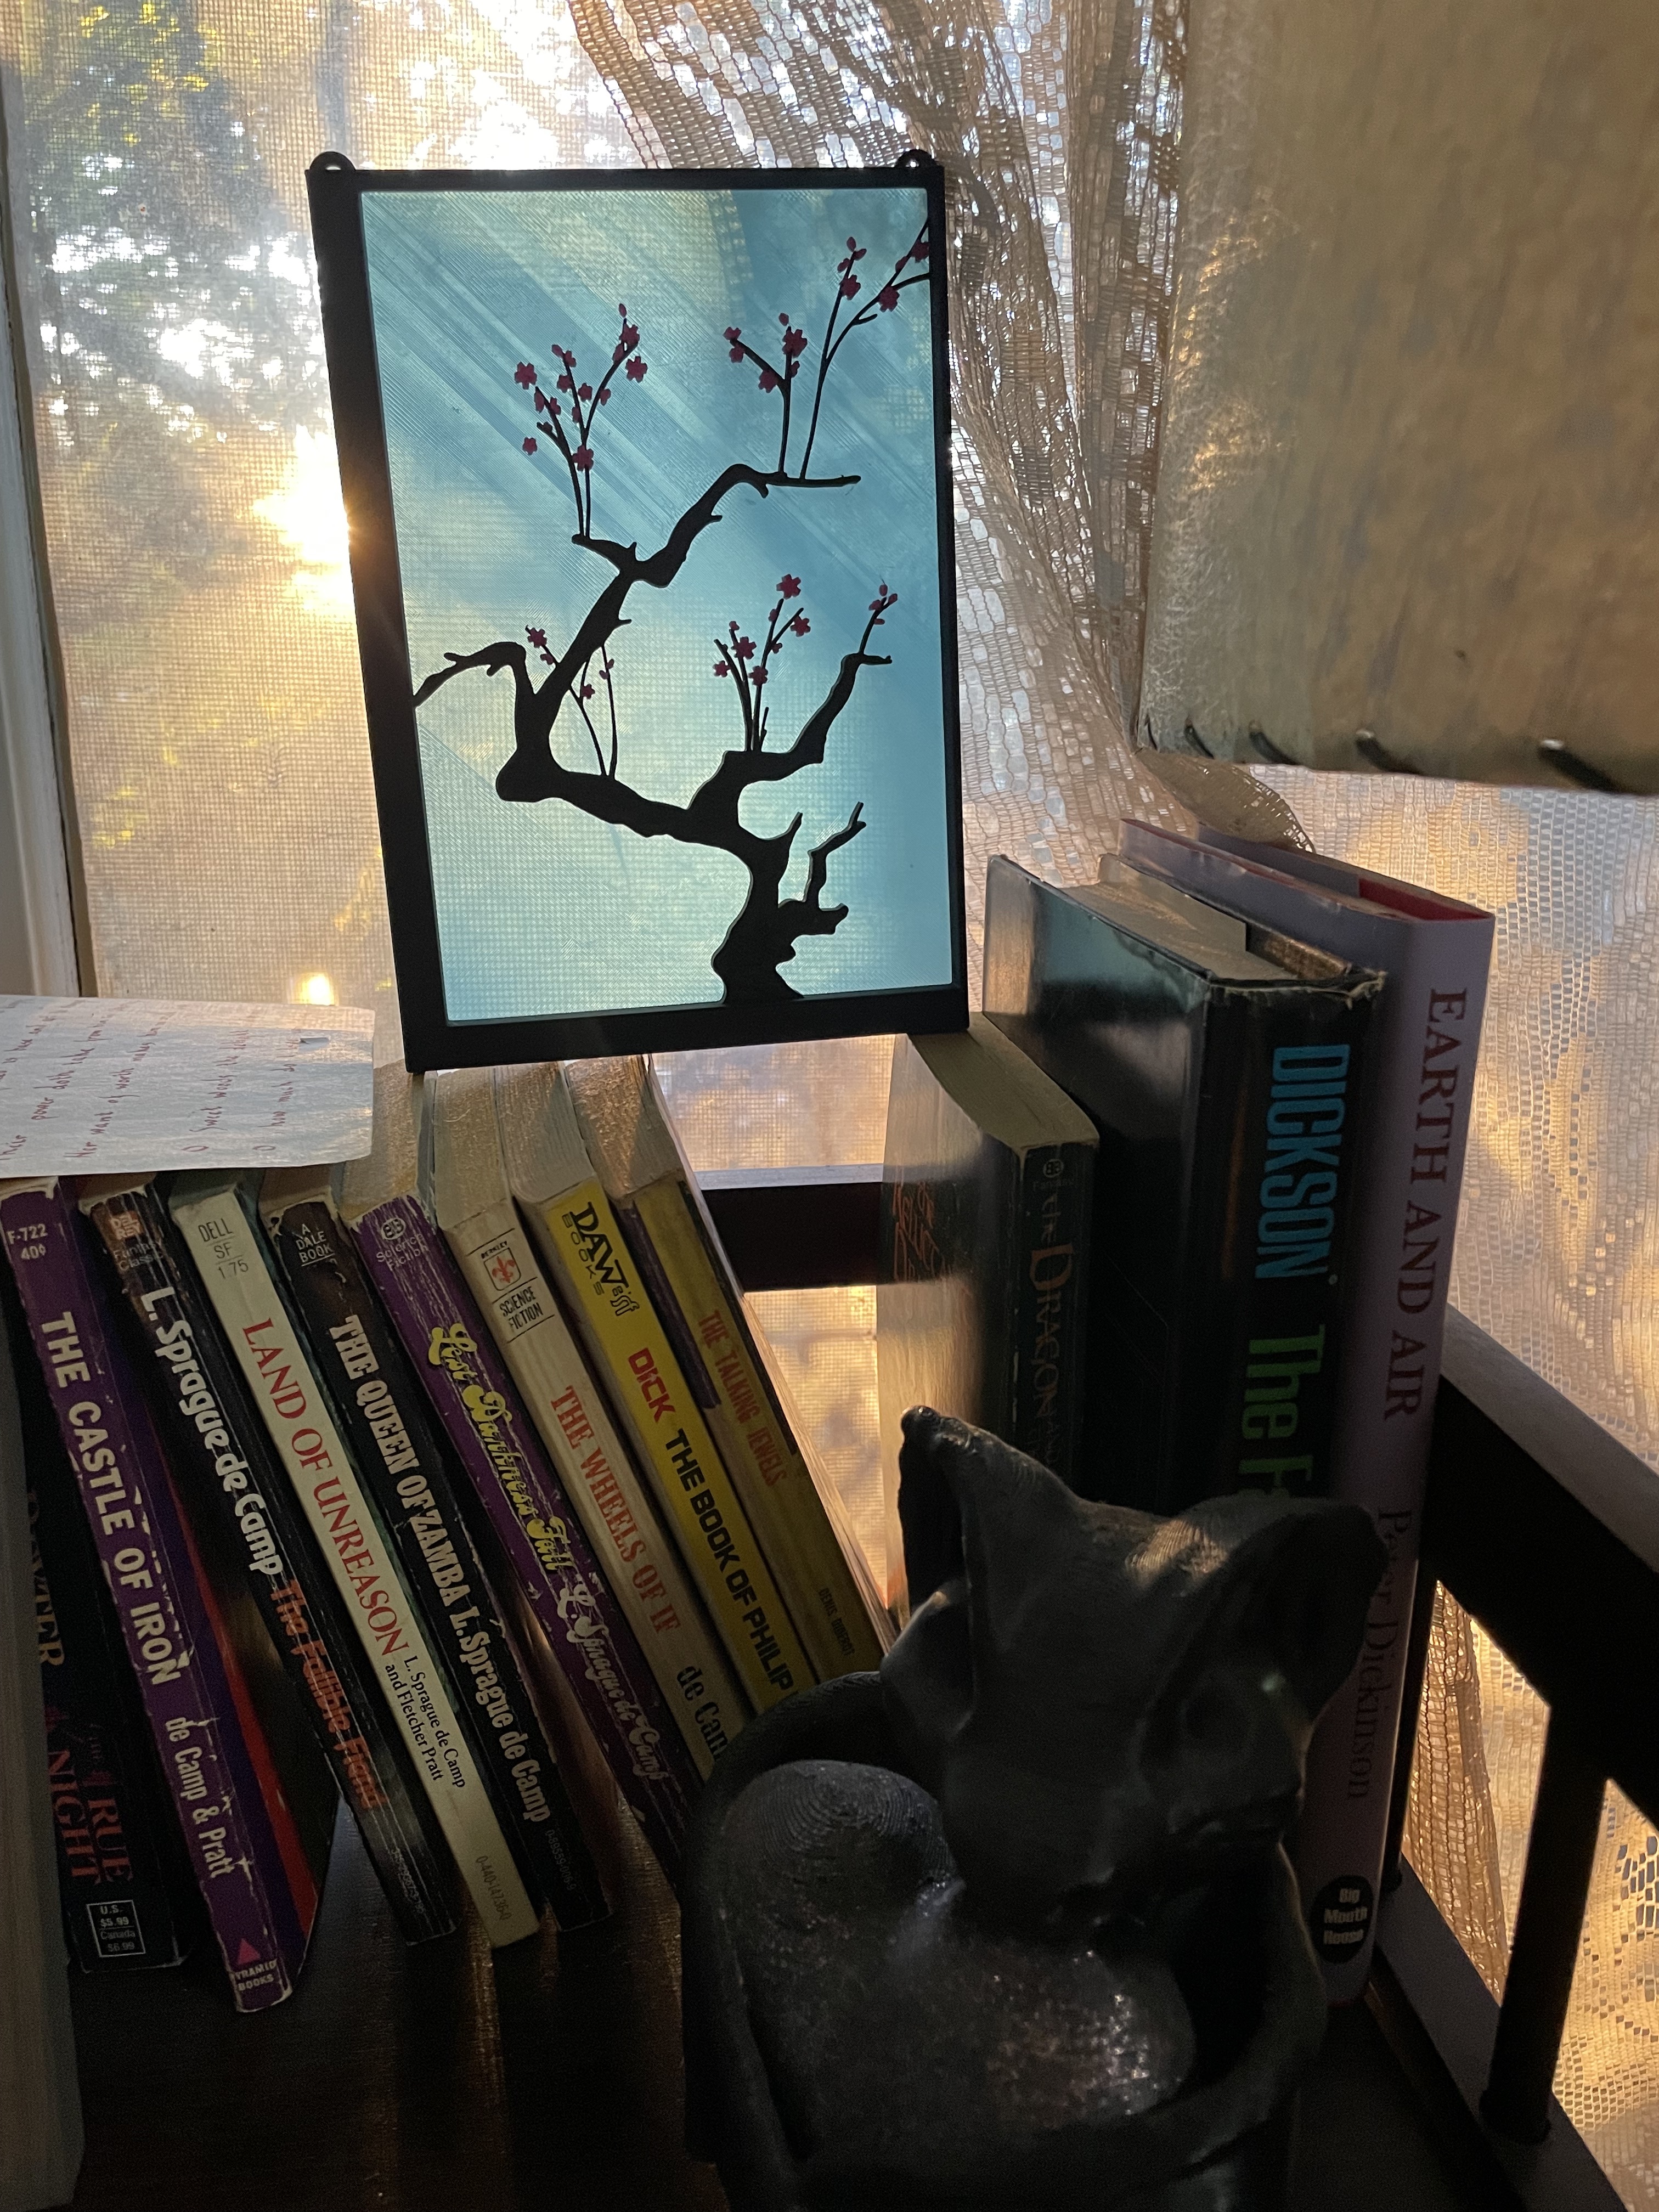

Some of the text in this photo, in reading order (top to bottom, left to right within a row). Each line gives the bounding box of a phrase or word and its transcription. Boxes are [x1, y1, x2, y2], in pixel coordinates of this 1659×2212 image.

[90, 1111, 114, 1135] want
[98, 1094, 140, 1104] of
[1255, 1043, 1352, 1279] DICKSON
[8, 1223, 48, 1244] F-722
[198, 1218, 233, 1243] DELL
[296, 1232, 328, 1251] DALE
[301, 1223, 309, 1234] A
[570, 1201, 630, 1288] DAW
[1384, 988, 1468, 1421] EARTH AND AIR
[213, 1242, 233, 1260] SF
[299, 1244, 334, 1262] BOOK
[561, 1213, 605, 1296] BOOKS
[499, 1286, 537, 1317] SCIENCE
[508, 1302, 544, 1330] FICTION
[329, 1314, 380, 1380] THE
[1241, 1323, 1327, 1441] The
[141, 1286, 285, 1576] L. Sprague de Camp
[356, 1380, 420, 1475] QUEEN
[698, 1309, 788, 1487] THE TALKING JEWELS
[242, 1318, 410, 1656] LAND OF UNREASON
[428, 1323, 577, 1571] Lest Darkness Fall
[42, 1311, 182, 1685] THE CASTLE OF IRON
[396, 1474, 437, 1510] OF
[550, 1385, 681, 1633] THE WHEELS OF IF
[627, 1347, 794, 1691] DICK THE BOOK OF PHILIP
[410, 1508, 471, 1607] ZAMBA
[557, 1583, 596, 1620] L.
[459, 1630, 514, 1729] Sprague
[566, 1616, 625, 1699] Sprague
[676, 1666, 705, 1701] de
[385, 1664, 444, 1781] and Fletcher Pratt
[404, 1656, 466, 1788] L. Sprague de Camp
[498, 1730, 529, 1760] de
[1347, 1619, 1399, 1801] Dickinson
[166, 1716, 236, 1879] de Camp & Pratt
[511, 1758, 551, 1823] Camp
[232, 1960, 278, 1980] YRAMID
[238, 1974, 275, 1992] BOOKS
